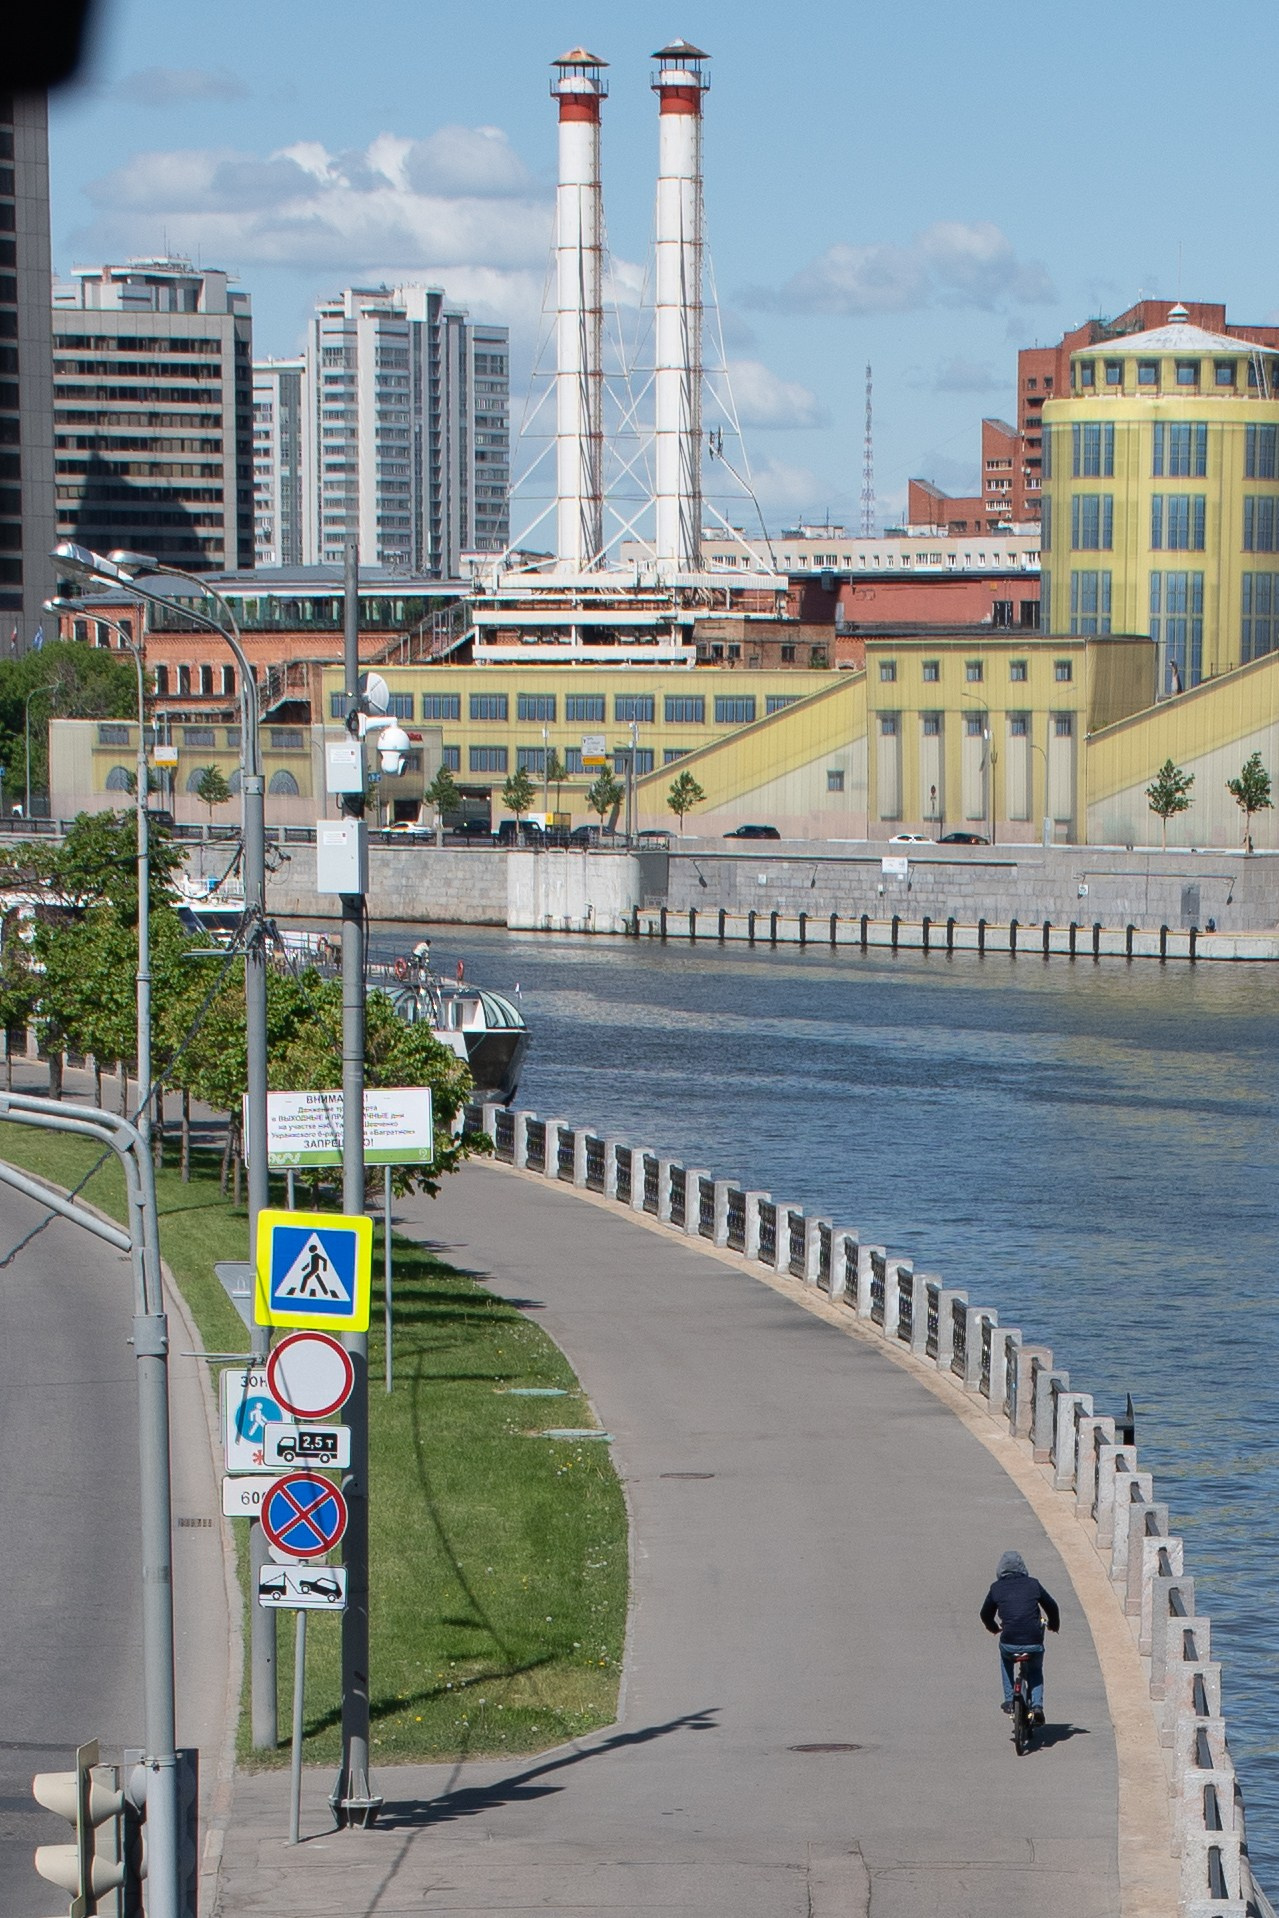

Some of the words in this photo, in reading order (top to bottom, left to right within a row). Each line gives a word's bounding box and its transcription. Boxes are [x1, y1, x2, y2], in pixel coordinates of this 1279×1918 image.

[306, 1094, 368, 1104] ВНИМА!
[240, 1375, 267, 1388] ЗОН
[302, 1436, 323, 1450] 2,5
